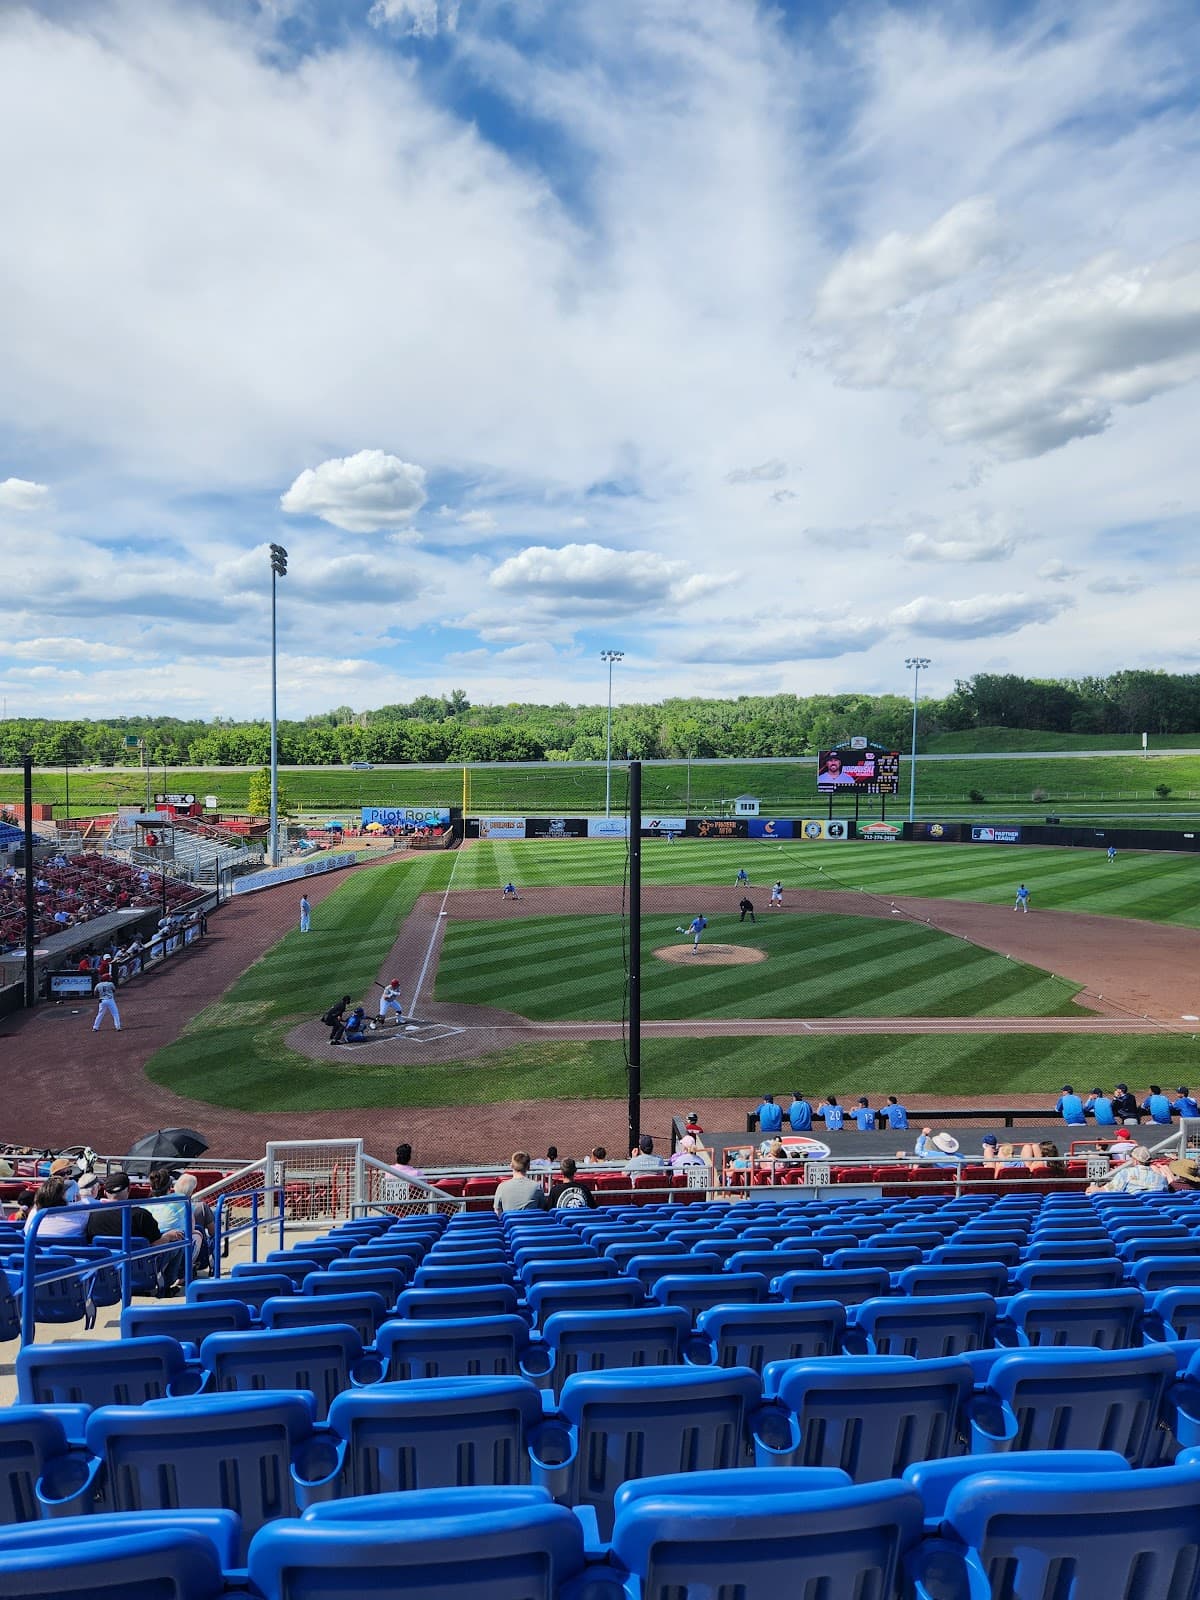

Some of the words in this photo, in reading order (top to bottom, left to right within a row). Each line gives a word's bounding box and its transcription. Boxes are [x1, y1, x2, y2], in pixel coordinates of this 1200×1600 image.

[371, 809, 401, 821] Pilot
[405, 809, 440, 821] Rock
[829, 1110, 841, 1121] 20
[864, 1113, 874, 1124] 13
[896, 1109, 902, 1119] 3
[1088, 1166, 1107, 1178] 94-96
[688, 1176, 708, 1188] 87-90
[809, 1173, 829, 1185] 91-93
